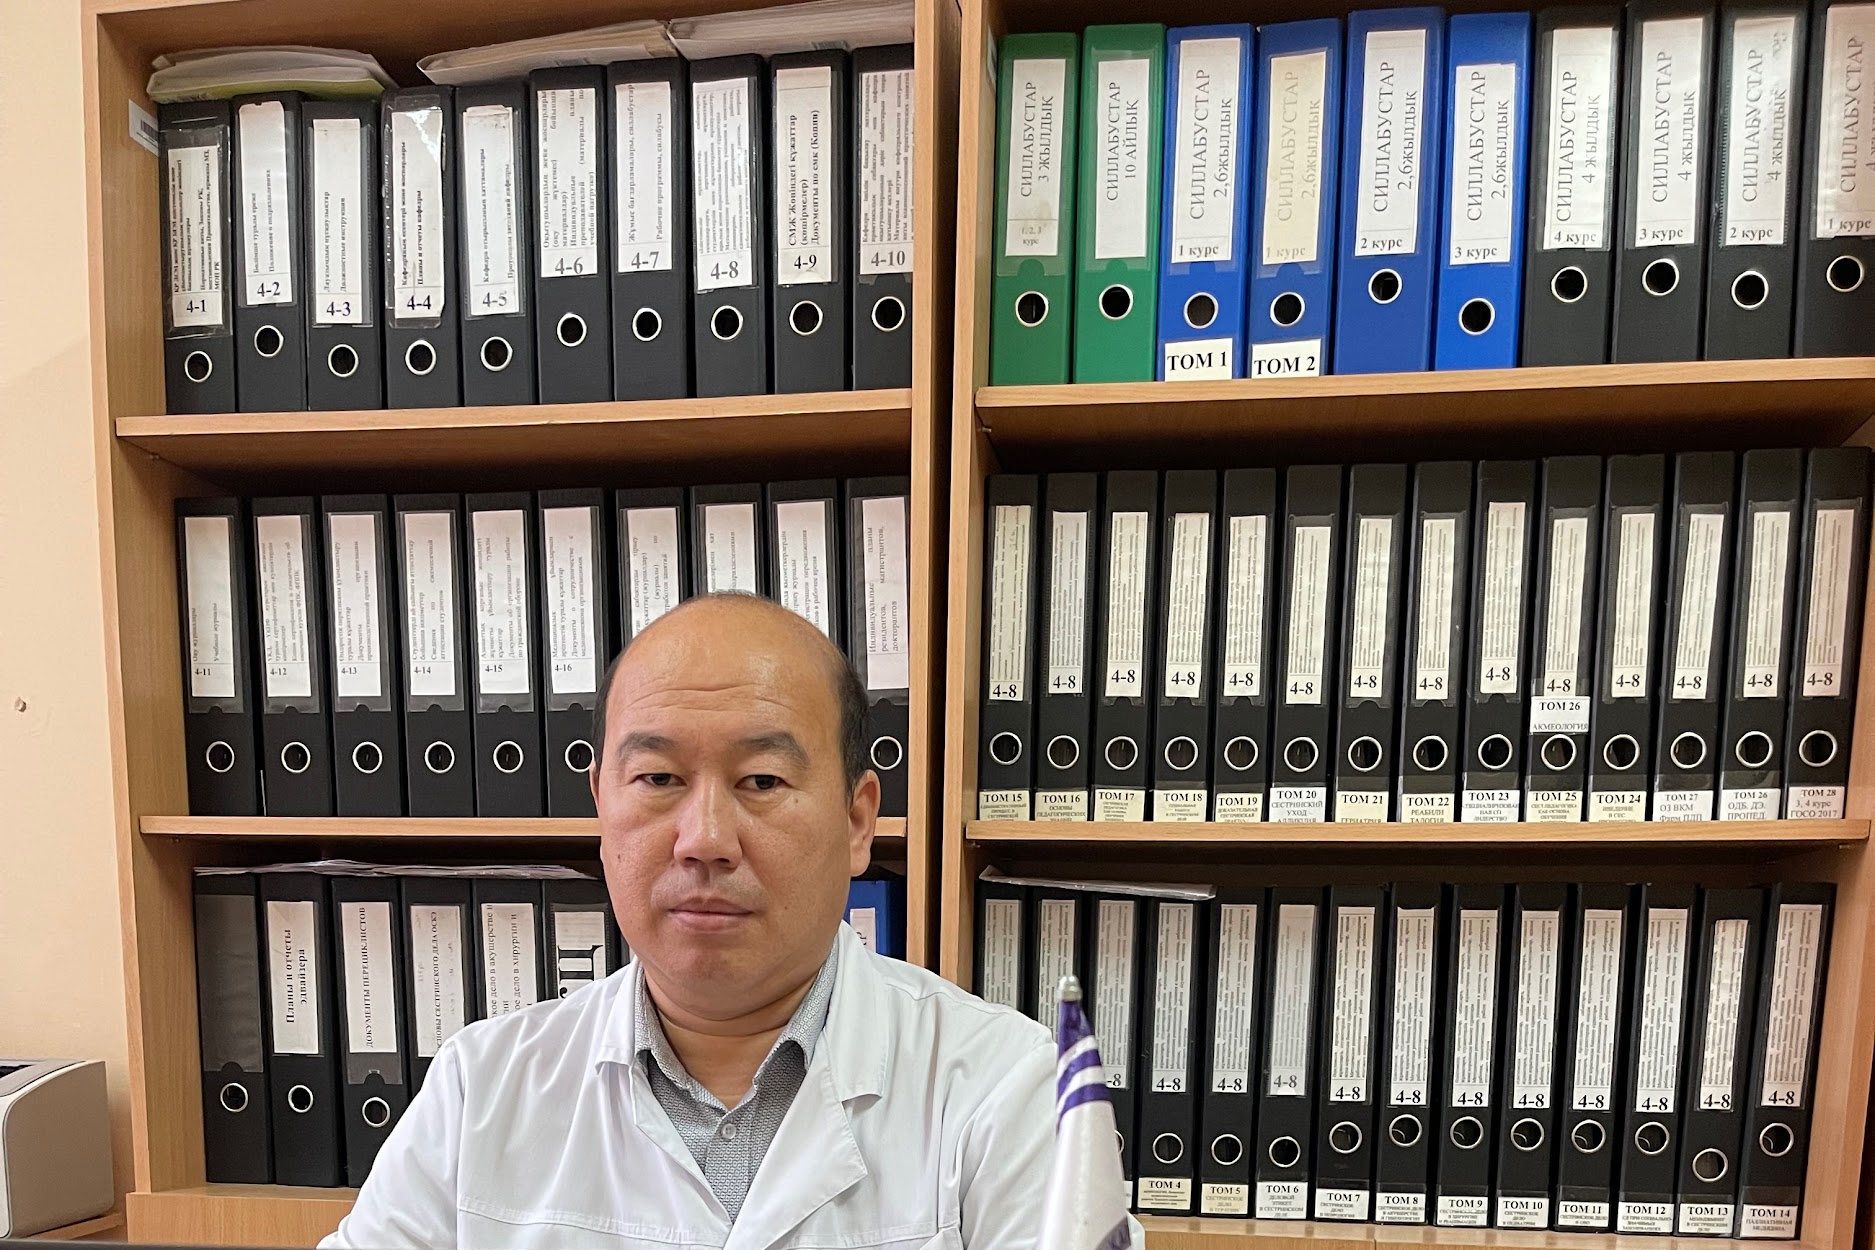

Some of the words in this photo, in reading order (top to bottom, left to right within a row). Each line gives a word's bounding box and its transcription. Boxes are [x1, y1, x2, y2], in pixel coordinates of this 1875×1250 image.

[1839, 36, 1865, 193] СИЛЛАБУСТАР
[1126, 99, 1140, 158] АЙЛЫК
[1653, 51, 1673, 203] СИЛЛАБУСТАР
[1742, 49, 1764, 202] СИЛЛАБУСТАР
[1020, 82, 1037, 198] СИЛЛАБУСТАР
[1106, 82, 1121, 201] СИЛЛАБУСТАР
[1189, 69, 1211, 220] СИЛЛАБУСТАР
[1373, 62, 1396, 213] СИЛЛАБУСТАР
[1277, 71, 1299, 222] СИЛЛАБУСТАР
[1467, 71, 1487, 222] СИЛЛАБУСТАР
[1556, 71, 1578, 223] СИЛЛАБУСТАР
[1038, 172, 1049, 183] 3
[1125, 162, 1137, 179] 10
[1582, 172, 1595, 184] 4
[1678, 170, 1691, 181] 4
[1553, 232, 1562, 243] 4
[1565, 231, 1597, 246] курс
[1639, 228, 1647, 240] 3
[1651, 227, 1684, 242] курс
[1730, 227, 1738, 239] 2
[1741, 227, 1773, 242] курс
[1179, 245, 1184, 256] 1
[1188, 245, 1219, 259] курс
[1361, 237, 1368, 250] 2
[1372, 237, 1403, 252] курс
[630, 251, 660, 268] 4-7
[870, 250, 906, 267] 4-10
[1454, 247, 1462, 259] 3
[1466, 246, 1498, 261] курс
[554, 257, 584, 275] 4-6
[710, 261, 739, 279] 4-8
[793, 255, 818, 270] 4-9
[256, 282, 281, 297] 4-2
[186, 299, 208, 313] 4-1
[406, 295, 432, 311] 4-4
[482, 291, 508, 307] 4-5
[326, 302, 352, 317] 4-3
[1167, 353, 1213, 372] ТОМ
[1220, 351, 1228, 367] 1
[1253, 357, 1300, 376] ТОМ
[1305, 355, 1316, 371] 2
[194, 668, 211, 676] 4-11
[270, 667, 287, 676] 4-12
[341, 667, 357, 675] 4-13
[414, 666, 431, 675] 4-14
[485, 664, 503, 673] 4-15
[554, 664, 572, 672] 4-16
[1486, 667, 1511, 681] 4-8
[1171, 671, 1196, 686] 4-8
[1616, 675, 1640, 688] 4-8
[1807, 673, 1833, 687] 4-8
[993, 685, 1017, 698] 4-8
[1277, 791, 1302, 799] ТОМ
[1305, 790, 1317, 799] 20
[1407, 797, 1432, 806] ТОМ
[1435, 797, 1449, 806] 22
[1596, 794, 1624, 804] ТОМ
[1628, 795, 1641, 803] 24
[487, 913, 496, 966] акушерстве
[284, 929, 292, 970] отчеты
[298, 949, 307, 1005] эдвайзера
[285, 984, 295, 1023] Планы
[363, 989, 373, 1048] ДОКУМЕНТЫ
[1156, 1078, 1181, 1091] 4-8
[1335, 1086, 1361, 1100] 4-8
[1641, 1097, 1668, 1111] 4-8
[1751, 1208, 1776, 1217] ТОМ
[1780, 1209, 1790, 1217] 14
